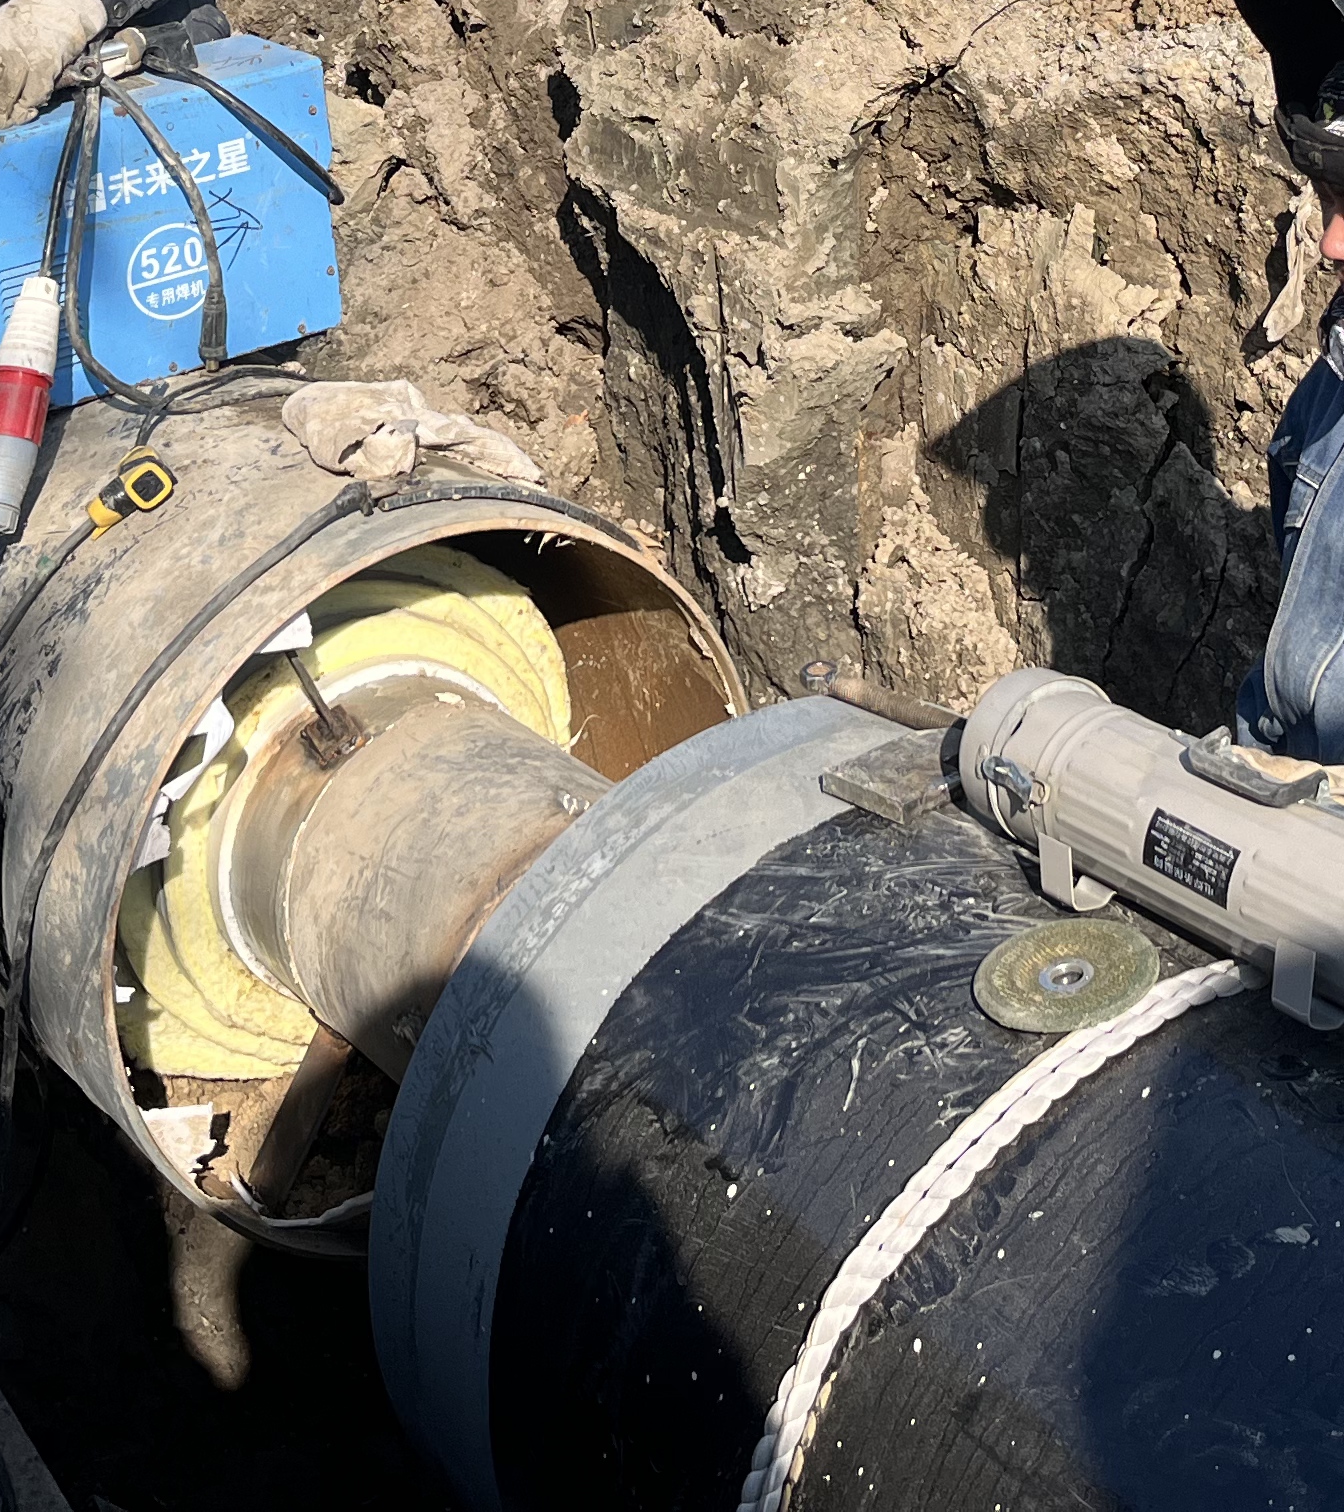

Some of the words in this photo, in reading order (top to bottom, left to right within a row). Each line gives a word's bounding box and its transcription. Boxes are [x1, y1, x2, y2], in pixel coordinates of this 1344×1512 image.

[108, 137, 251, 206] 未来之星
[140, 236, 203, 280] 520
[145, 279, 207, 309] 专用焊机
